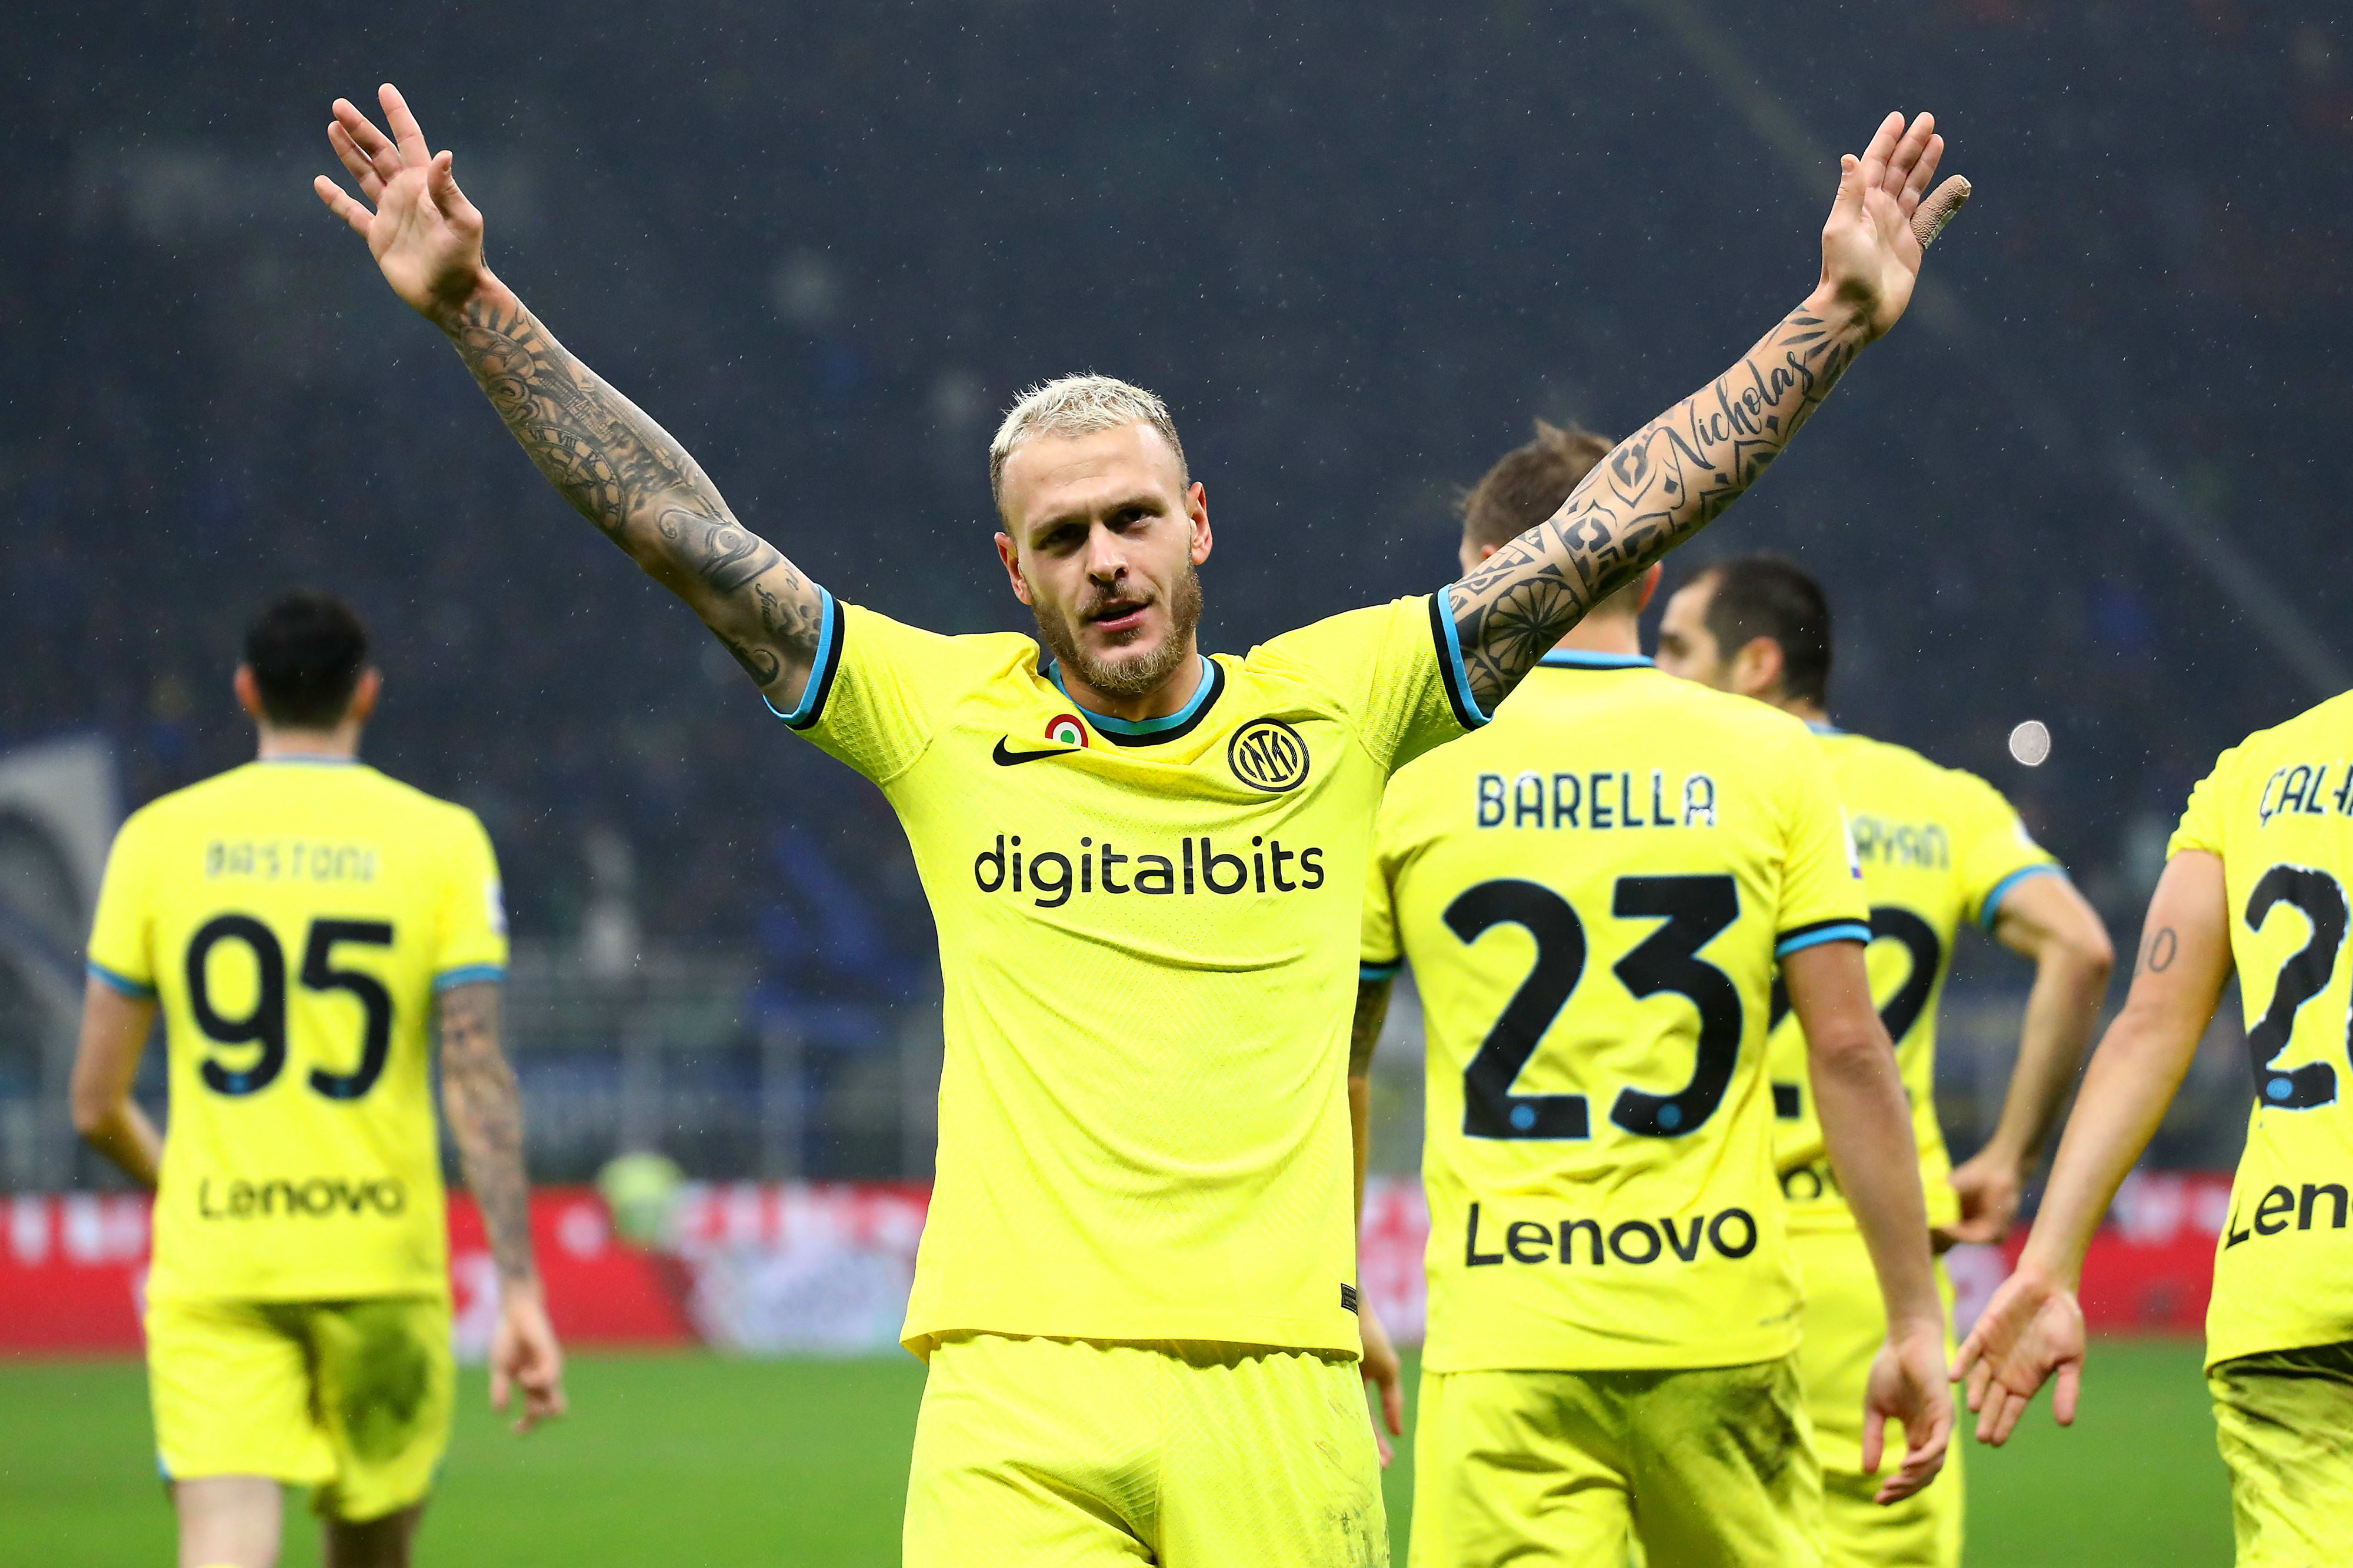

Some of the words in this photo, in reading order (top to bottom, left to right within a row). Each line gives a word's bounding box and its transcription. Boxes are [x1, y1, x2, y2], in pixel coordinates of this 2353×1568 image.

[1644, 351, 1814, 510] Nicholas
[1476, 772, 1717, 828] BARELLA
[974, 834, 1325, 908] digitalbits
[185, 912, 395, 1100] 95
[1441, 873, 1742, 1140] 23
[2244, 863, 2353, 1110] 2
[199, 1176, 406, 1220] Lenovo
[1465, 1202, 1758, 1268] Lenovo
[2224, 1183, 2353, 1251] Len
